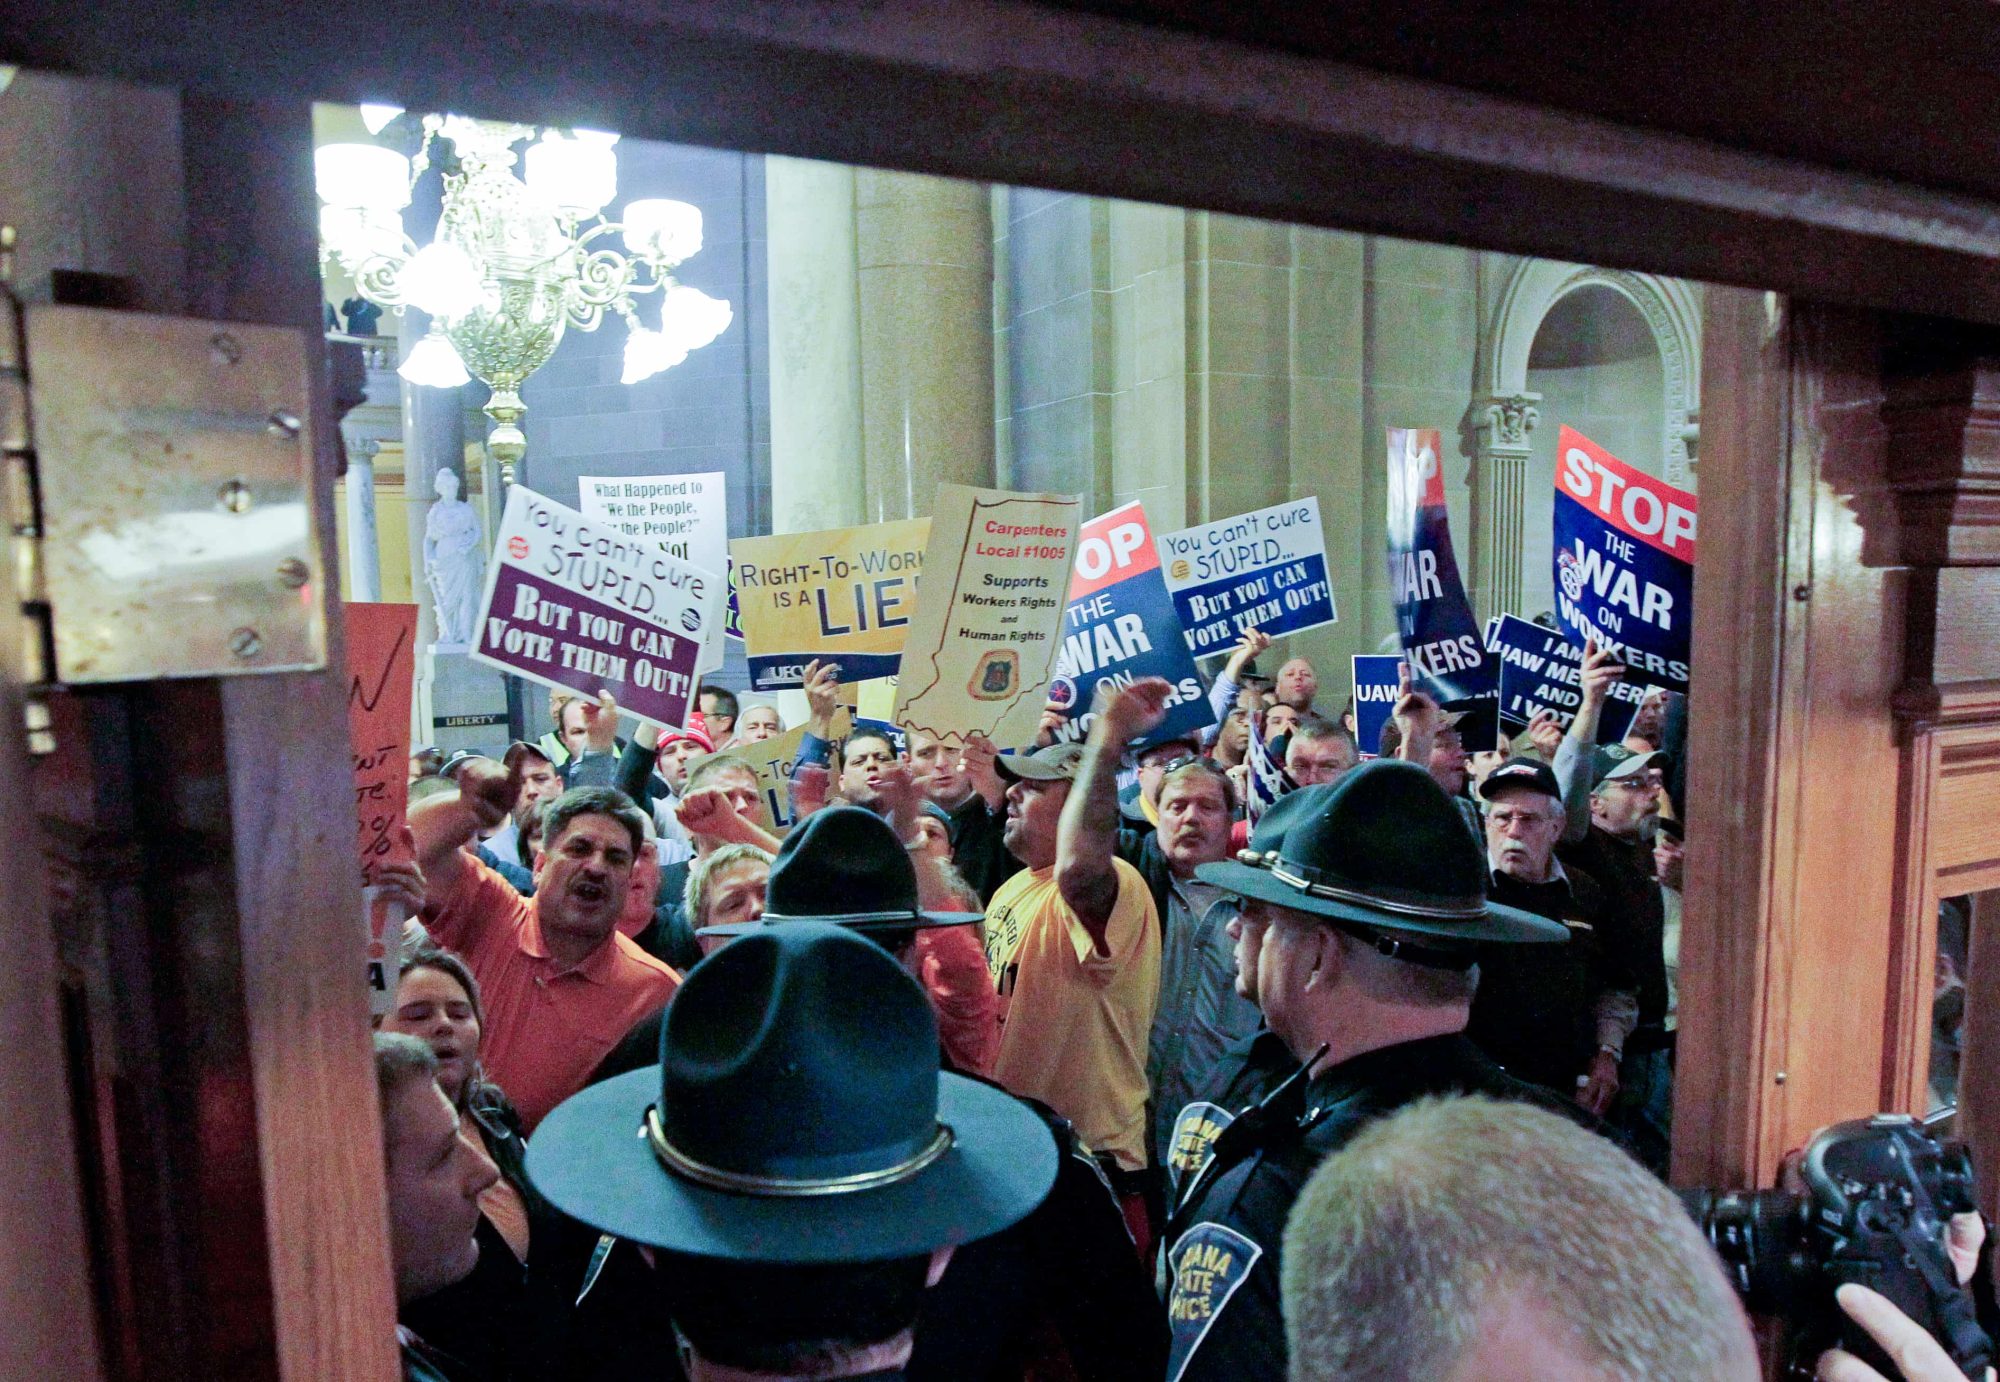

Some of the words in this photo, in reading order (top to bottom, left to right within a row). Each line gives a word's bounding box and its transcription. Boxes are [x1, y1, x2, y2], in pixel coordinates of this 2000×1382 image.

[594, 484, 620, 497] What
[624, 482, 687, 498] Happened
[691, 482, 702, 494] to
[1563, 448, 1697, 548] STOP
[626, 502, 646, 516] the
[621, 521, 640, 535] the
[985, 520, 1067, 538] Carpenters
[1166, 537, 1201, 555] You
[1207, 515, 1259, 546] can't
[1266, 507, 1311, 531] cure
[524, 495, 567, 536] You
[575, 527, 645, 569] can't
[651, 559, 706, 600] cure
[975, 543, 1020, 558] Local
[1023, 546, 1065, 559] #1005
[1075, 522, 1146, 580] OP
[1604, 530, 1636, 564] THE
[983, 573, 1049, 590] Supports
[1188, 591, 1233, 623] BUT
[1234, 577, 1270, 604] YOU
[1273, 561, 1308, 589] CAN
[1402, 549, 1444, 604] AR
[1575, 538, 1674, 630] WAR
[773, 592, 791, 608] IS
[798, 590, 812, 606] A
[963, 593, 1016, 607] Workers
[1020, 596, 1057, 609] Rights
[1066, 593, 1115, 627] THE
[1183, 620, 1231, 651] VOTE
[1284, 581, 1329, 611] OUT!
[512, 583, 573, 631] BUT
[578, 609, 625, 646] YOU
[629, 627, 676, 660] CAN
[959, 628, 1006, 641] Human
[1009, 631, 1046, 643] Rights
[1001, 615, 1018, 624] and
[1597, 607, 1623, 634] ON
[1062, 613, 1153, 679] WAR
[1543, 637, 1554, 652] I
[1558, 592, 1689, 682] WORKERS
[487, 617, 555, 663] VOTE
[560, 641, 628, 682] THEM
[633, 658, 691, 698] OUT!
[1406, 634, 1482, 681] KERS
[1494, 641, 1545, 672] UAW
[1544, 661, 1646, 704] MEBER
[1096, 669, 1135, 698] ON
[1534, 684, 1580, 707] AND
[445, 715, 496, 727] LIBERTY
[1511, 695, 1523, 711] I
[1524, 700, 1577, 730] VOT
